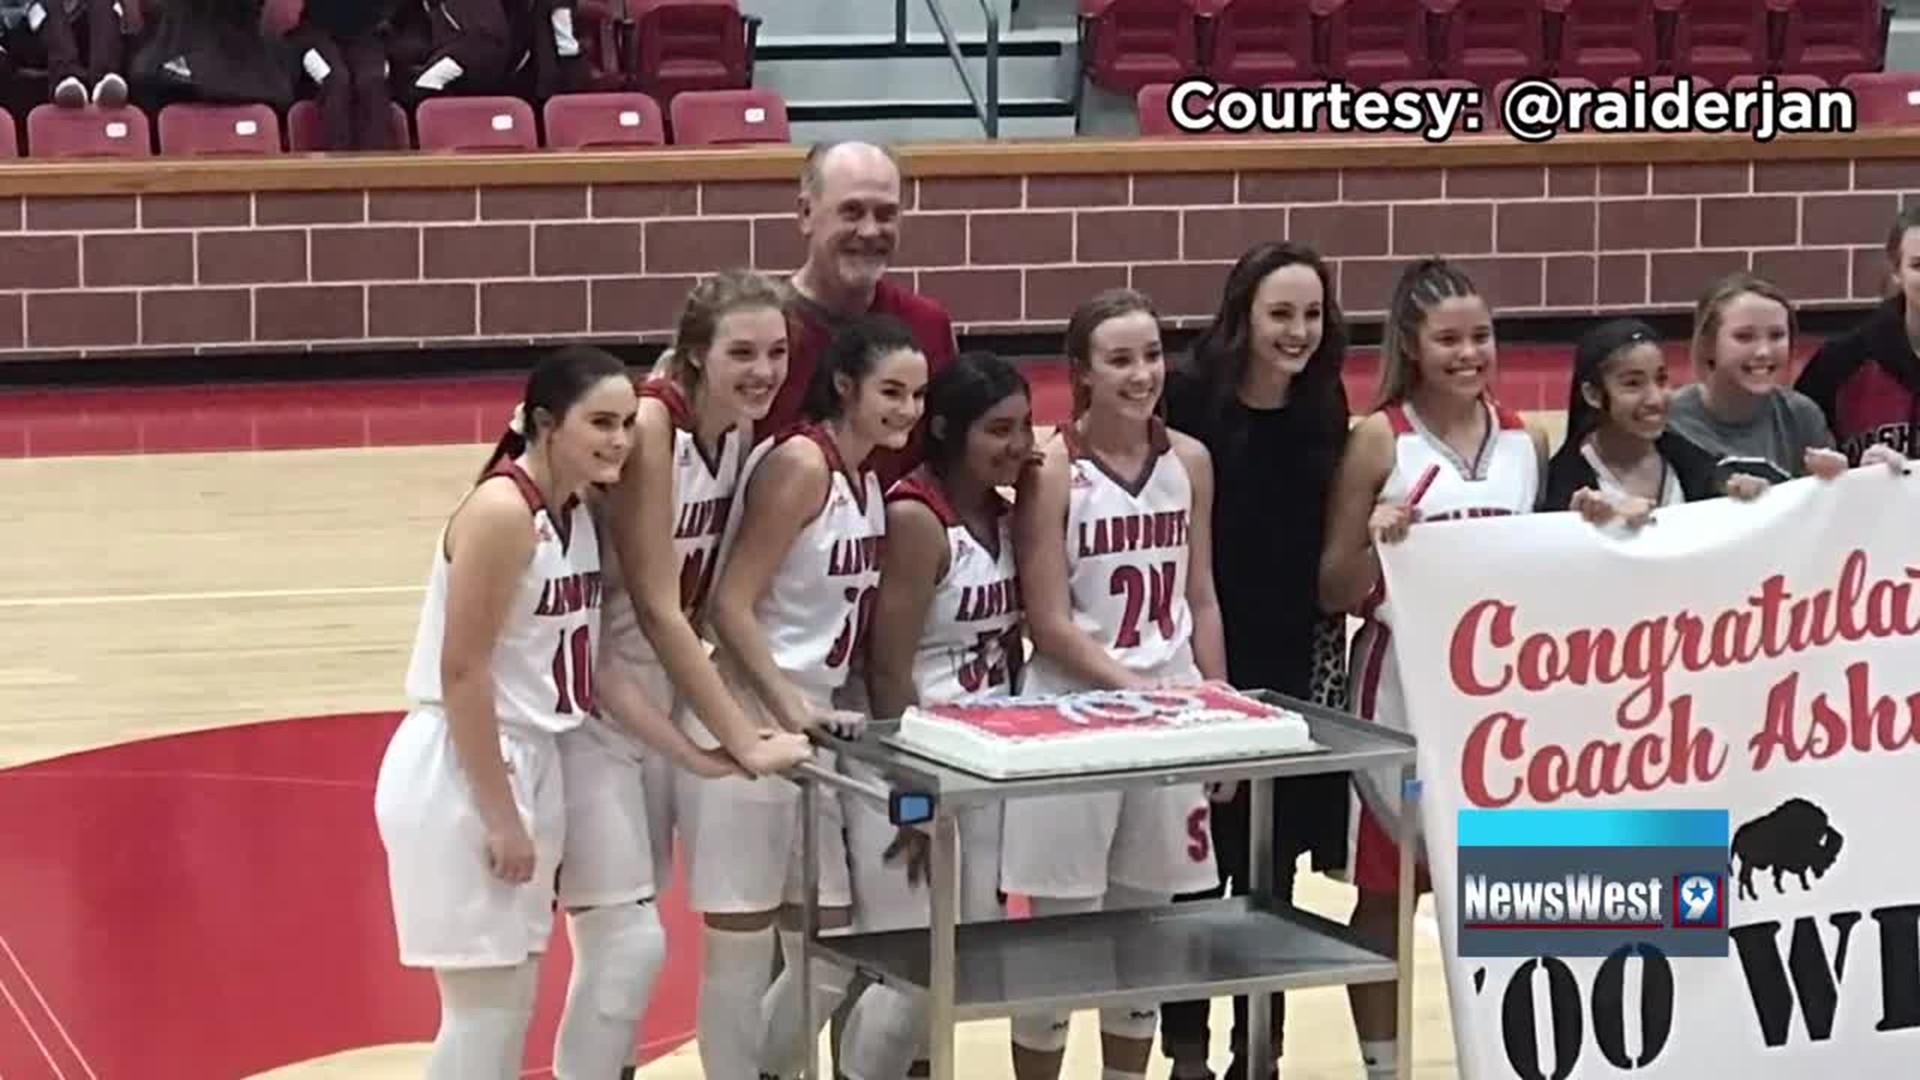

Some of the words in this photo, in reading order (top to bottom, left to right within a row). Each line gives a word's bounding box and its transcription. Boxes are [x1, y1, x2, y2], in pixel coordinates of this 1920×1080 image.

[1110, 561, 1177, 649] 24
[1461, 711, 1729, 808] Coach
[1187, 808, 1209, 863] S
